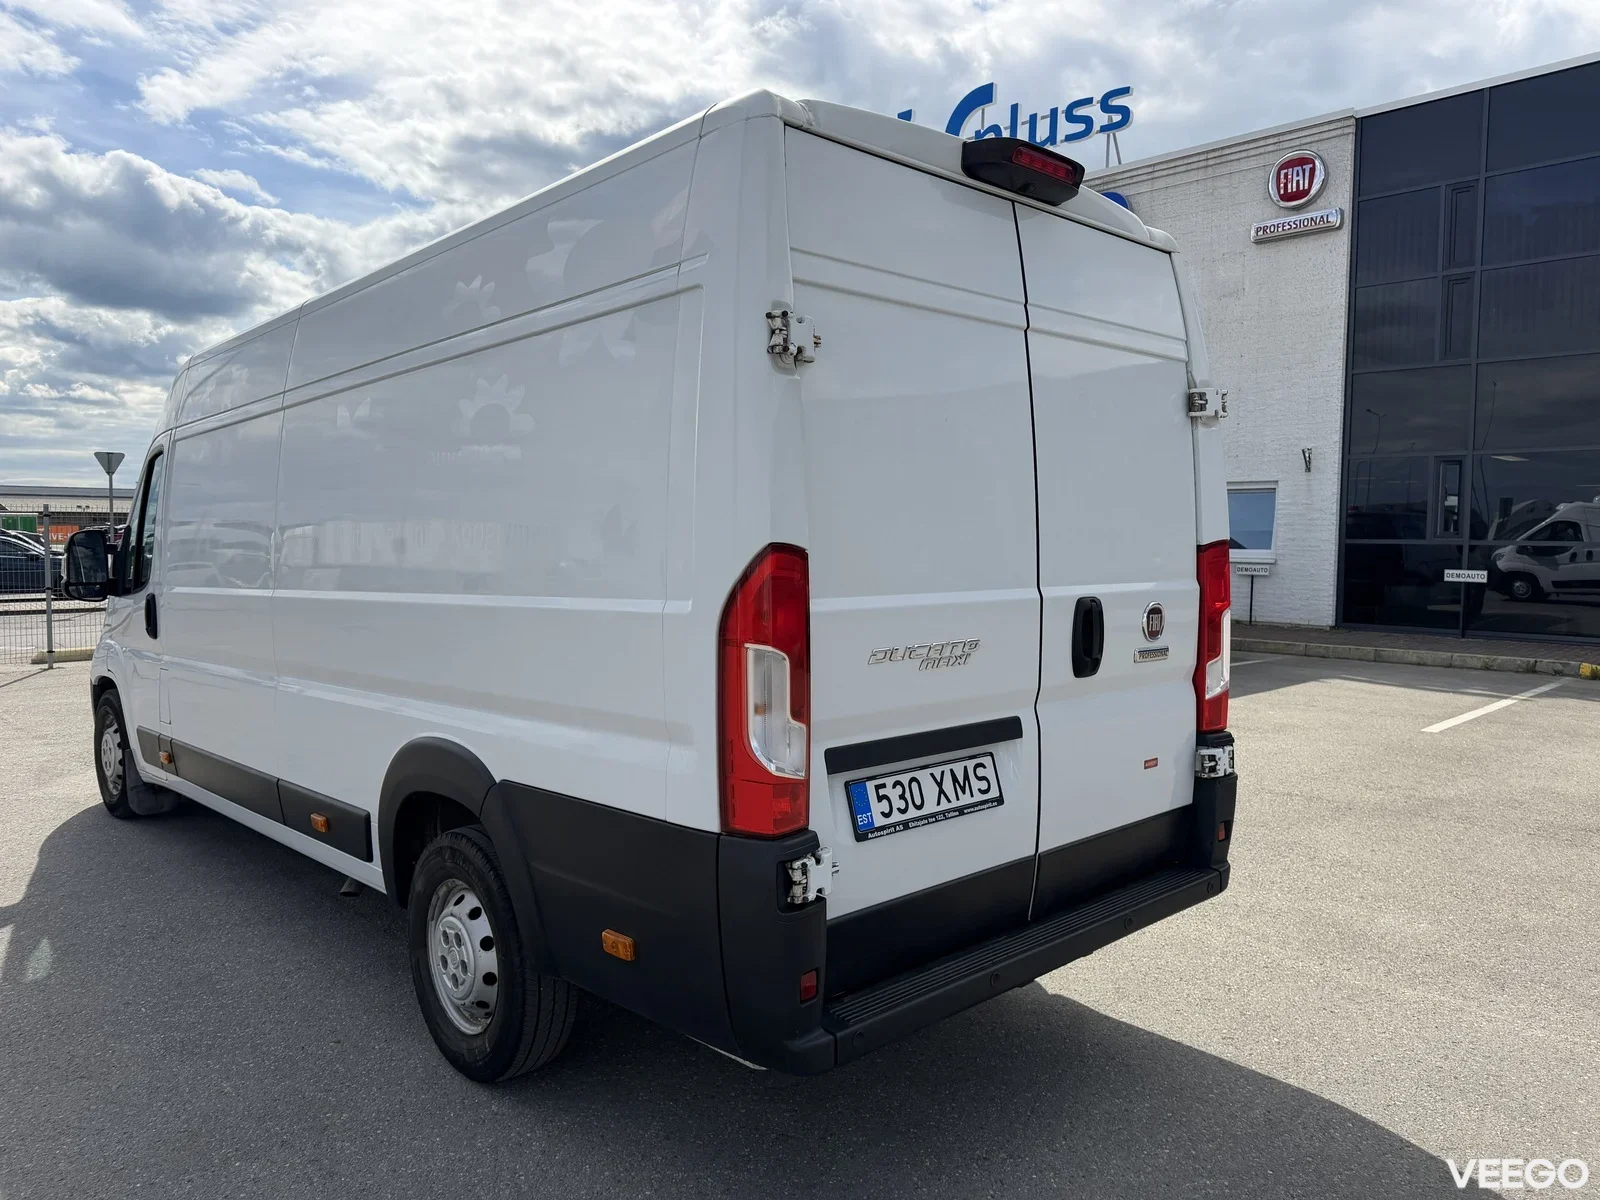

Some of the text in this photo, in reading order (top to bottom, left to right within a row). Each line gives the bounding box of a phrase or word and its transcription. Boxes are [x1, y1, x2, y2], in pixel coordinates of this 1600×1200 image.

[1279, 164, 1314, 195] FIAT
[1255, 213, 1332, 237] PROFESSIONAL
[1445, 572, 1486, 580] DEMOAUTO
[1149, 614, 1162, 631] FIAT
[867, 638, 981, 665] DUCATO
[873, 762, 992, 819] 530 XMS
[857, 812, 873, 826] EST
[867, 827, 896, 839] Autospirit
[895, 824, 904, 832] AS
